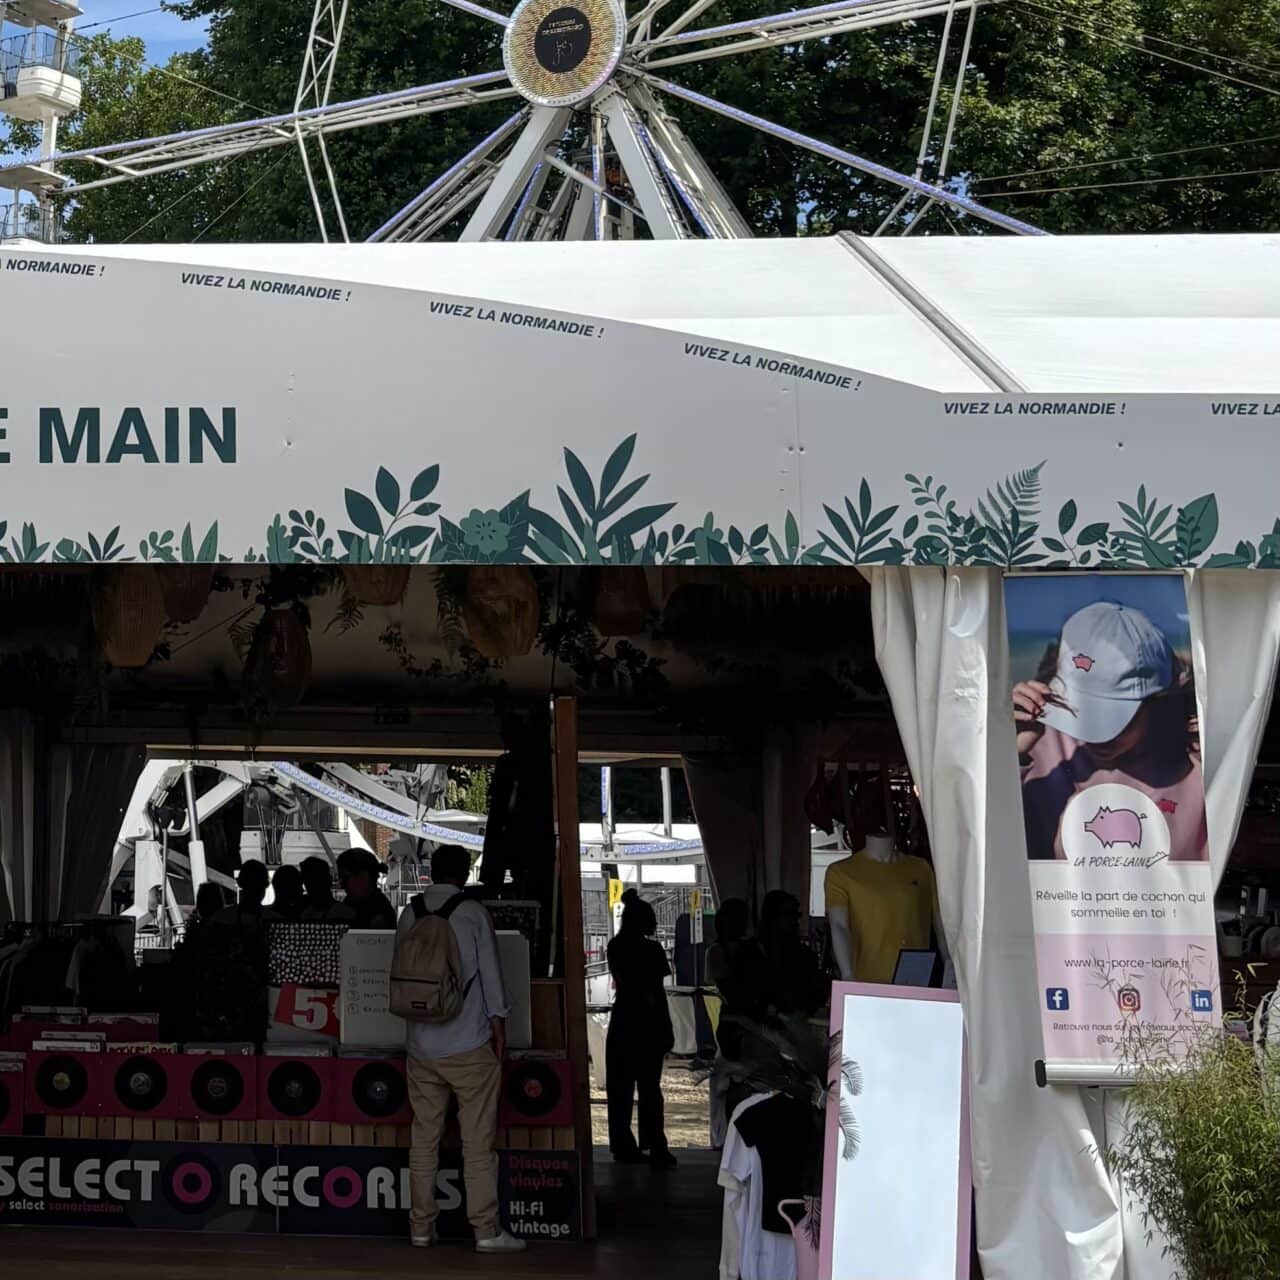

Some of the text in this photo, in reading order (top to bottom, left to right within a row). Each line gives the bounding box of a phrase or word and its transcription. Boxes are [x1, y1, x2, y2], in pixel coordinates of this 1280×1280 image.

[5, 258, 97, 277] NORMANDIE
[181, 271, 225, 288] VIVEZ
[226, 276, 246, 290] LA
[249, 279, 344, 301] NORMANDIE
[430, 300, 475, 318] VIVEZ
[476, 307, 496, 322] LA
[499, 311, 595, 337] NORMANDIE
[684, 342, 730, 362] VIVEZ
[732, 352, 753, 368] LA
[755, 357, 853, 386] NORMANDIE
[944, 402, 990, 415] VIVEZ
[993, 402, 1014, 415] LA
[1017, 402, 1117, 415] NORMANDIE
[1211, 402, 1280, 416] VIVEZ LA
[39, 407, 237, 464] MAIN
[1073, 856, 1152, 868] LA PORCE-LAINE
[1035, 889, 1206, 904] Réveille la part de cochon qui
[1071, 906, 1130, 919] sommeille
[1132, 909, 1148, 919] en
[1150, 907, 1166, 919] toi
[508, 1155, 569, 1172] Disques
[508, 1174, 564, 1191] vinyles
[7, 1198, 46, 1212] select
[509, 1200, 545, 1217] Hi-Fi
[509, 1219, 571, 1238] vintage
